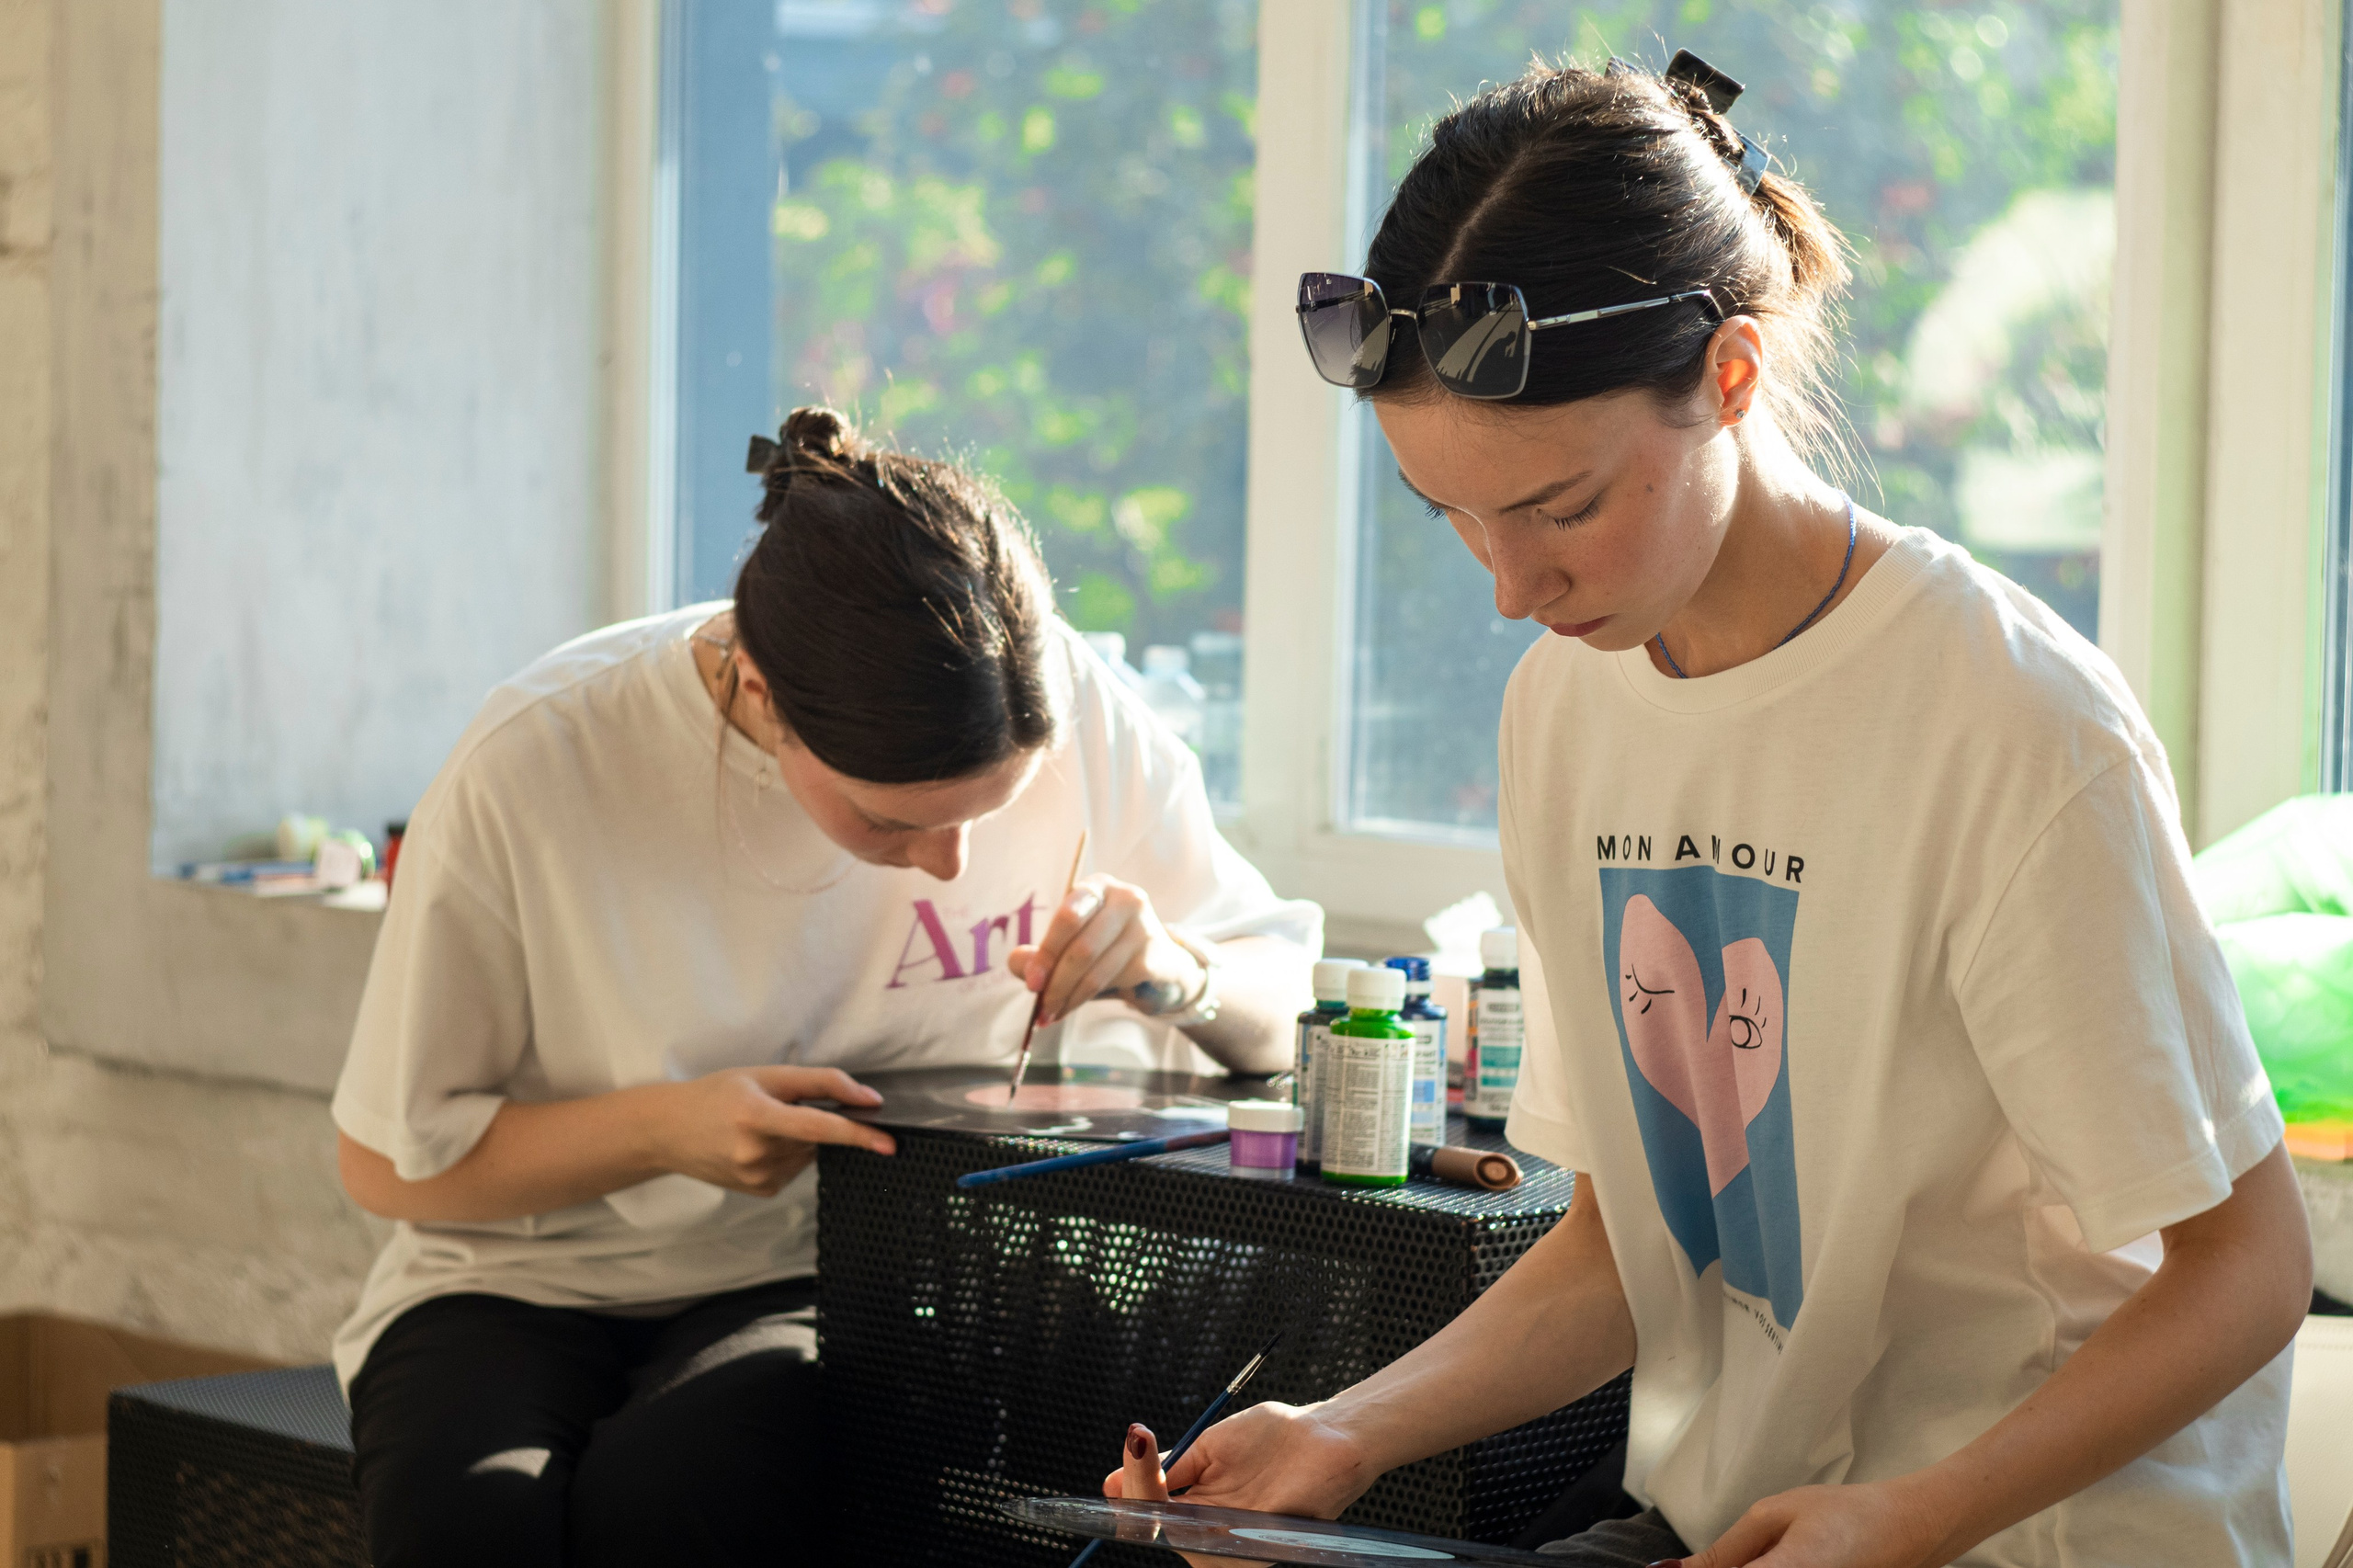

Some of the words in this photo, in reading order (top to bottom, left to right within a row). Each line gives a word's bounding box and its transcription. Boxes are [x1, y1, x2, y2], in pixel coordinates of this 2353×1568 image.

[1597, 835, 1652, 861] MON
[1675, 835, 1805, 883] AMOUR
[885, 893, 1048, 990] Art
